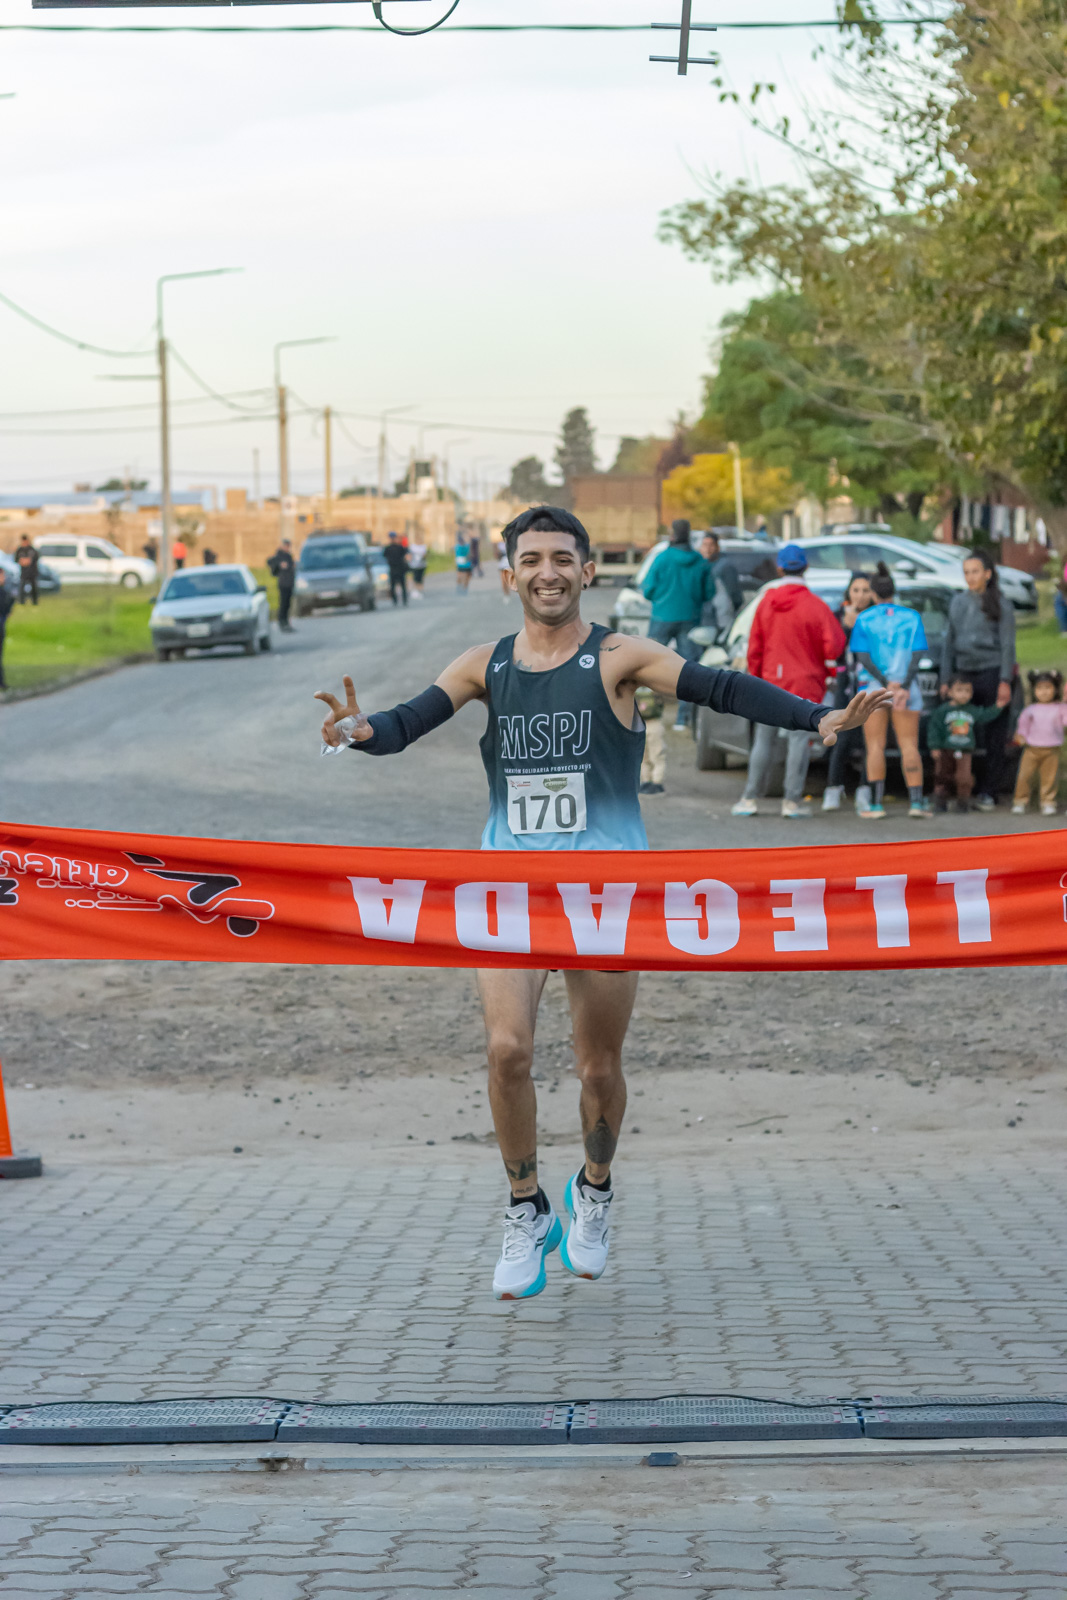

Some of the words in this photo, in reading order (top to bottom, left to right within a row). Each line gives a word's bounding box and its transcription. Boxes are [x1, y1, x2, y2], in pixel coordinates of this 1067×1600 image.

[498, 709, 591, 759] MSPJ
[522, 766, 549, 774] SOLIDARIA
[550, 764, 578, 772] PROYECTO
[512, 793, 577, 830] 170
[346, 868, 992, 955] LLEGADA
